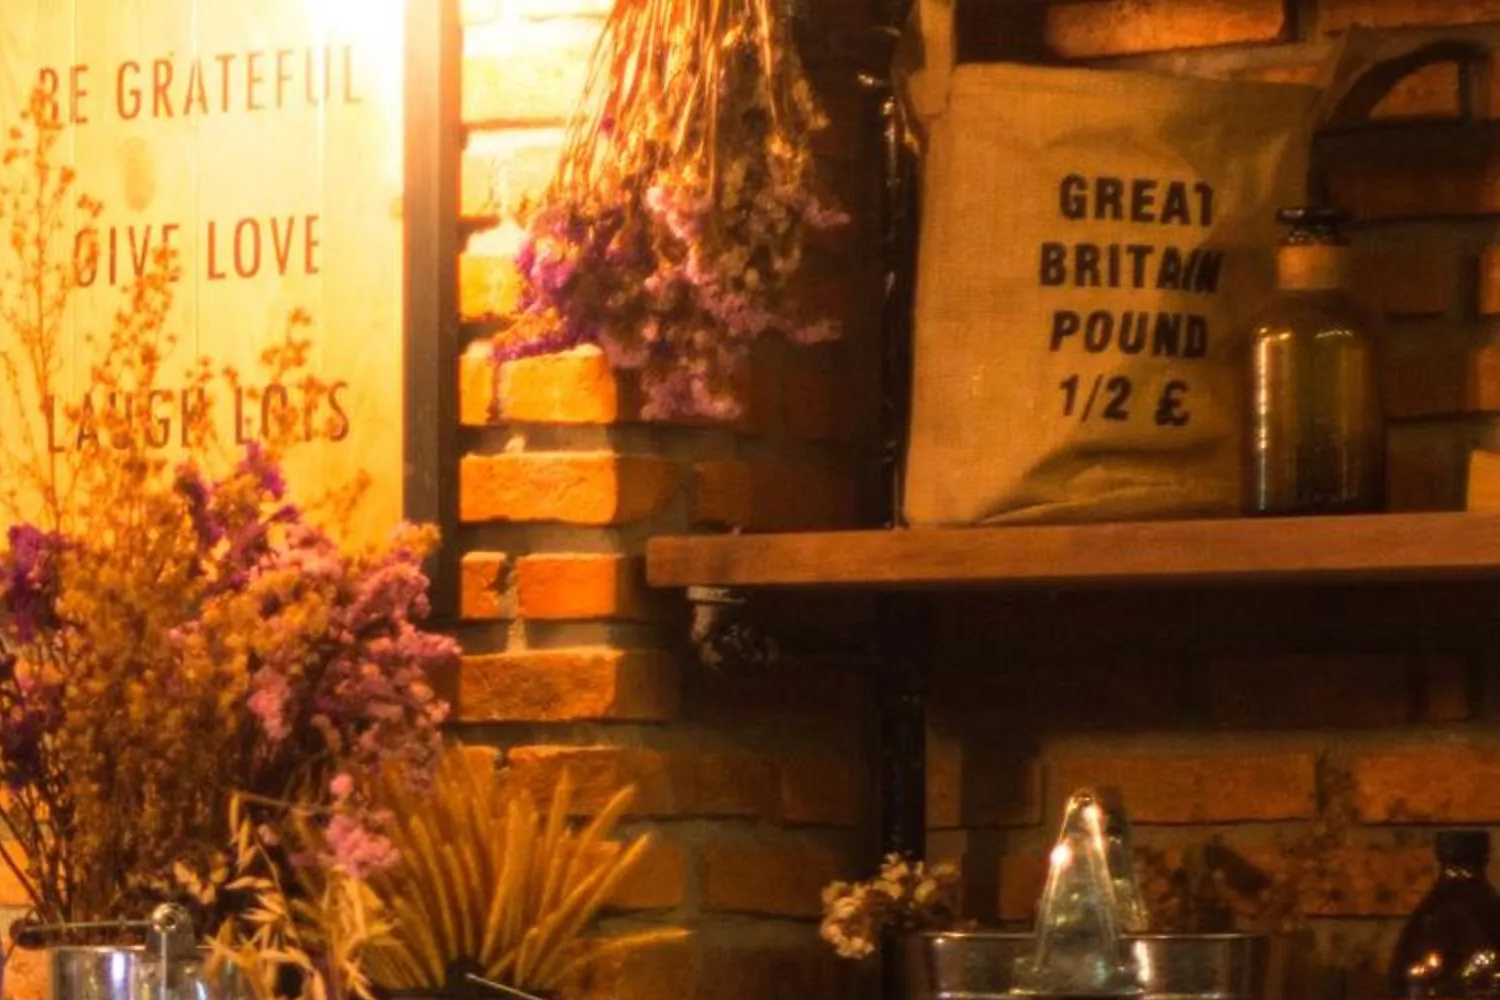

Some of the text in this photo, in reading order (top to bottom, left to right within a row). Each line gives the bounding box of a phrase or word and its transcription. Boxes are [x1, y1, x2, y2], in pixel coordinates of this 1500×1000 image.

[37, 44, 362, 129] BE GRATEFUL
[1059, 174, 1214, 226] GREAT
[73, 214, 319, 288] GIVE LOVE
[1040, 242, 1226, 294] BRITAIN
[1049, 309, 1209, 358] POUND
[1059, 373, 1192, 427] 1/2 £
